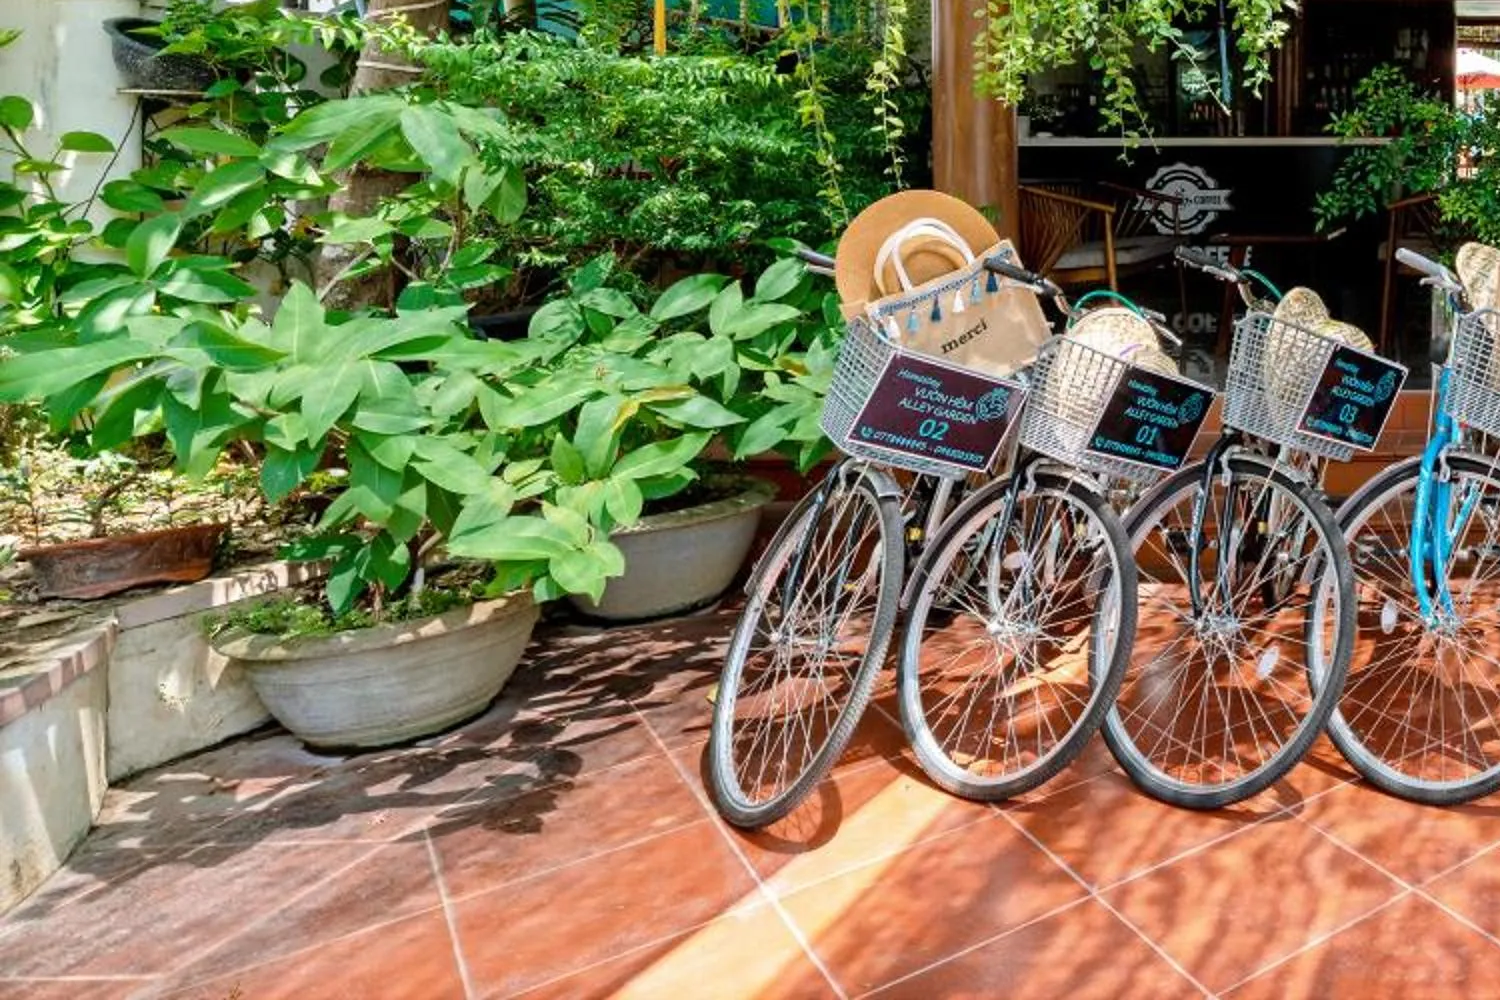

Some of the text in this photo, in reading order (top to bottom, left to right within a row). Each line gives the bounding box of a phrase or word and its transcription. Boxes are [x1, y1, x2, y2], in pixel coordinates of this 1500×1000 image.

[940, 316, 988, 354] merci
[898, 398, 977, 425] ALLEY GARDEN
[1339, 403, 1358, 424] 03
[919, 418, 949, 441] 02
[1135, 425, 1159, 446] 01
